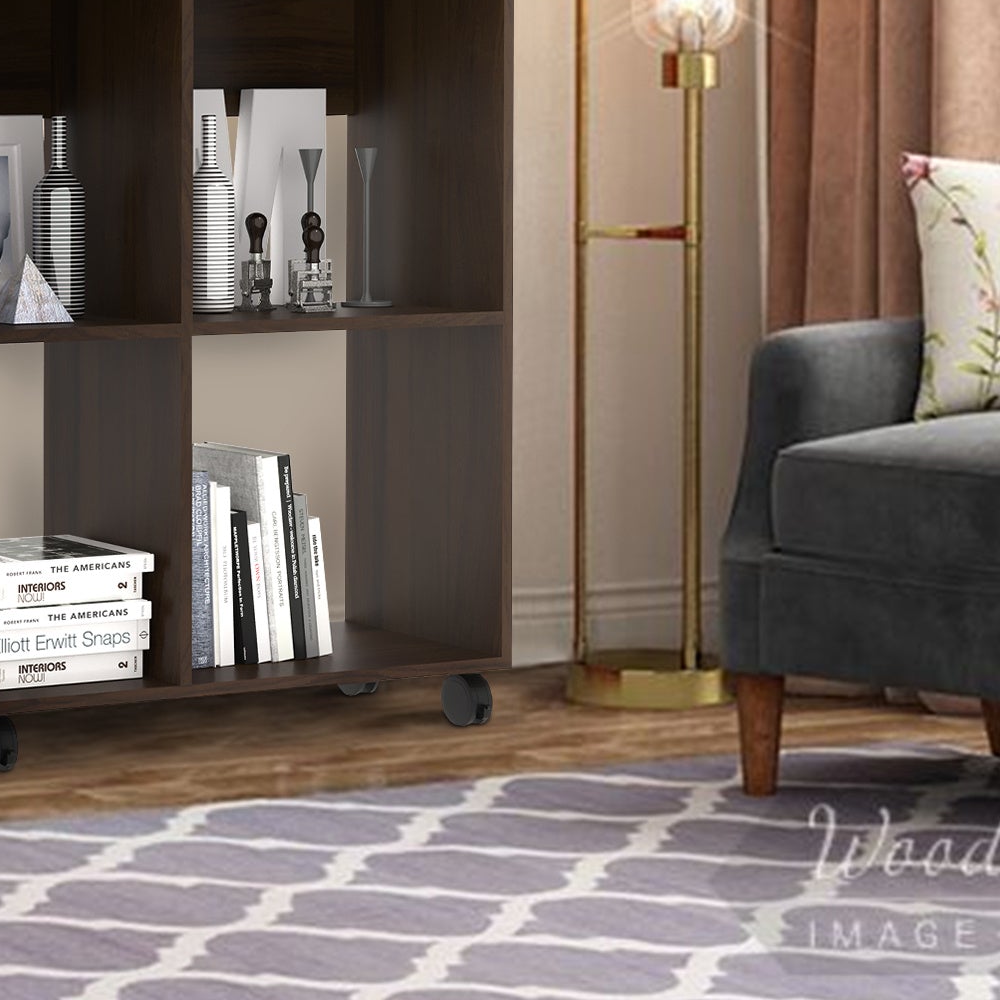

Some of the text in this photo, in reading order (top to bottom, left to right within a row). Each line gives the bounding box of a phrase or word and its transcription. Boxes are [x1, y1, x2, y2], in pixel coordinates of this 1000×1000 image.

[73, 561, 131, 572] AMERICANS
[18, 582, 66, 593] INTERIORS
[18, 593, 44, 603] NOW!
[70, 608, 128, 620] AMERICANS
[36, 633, 77, 651] Erwitt
[82, 630, 131, 648] Snaps
[18, 662, 66, 674] INTERIORS
[18, 673, 45, 684] NOW!
